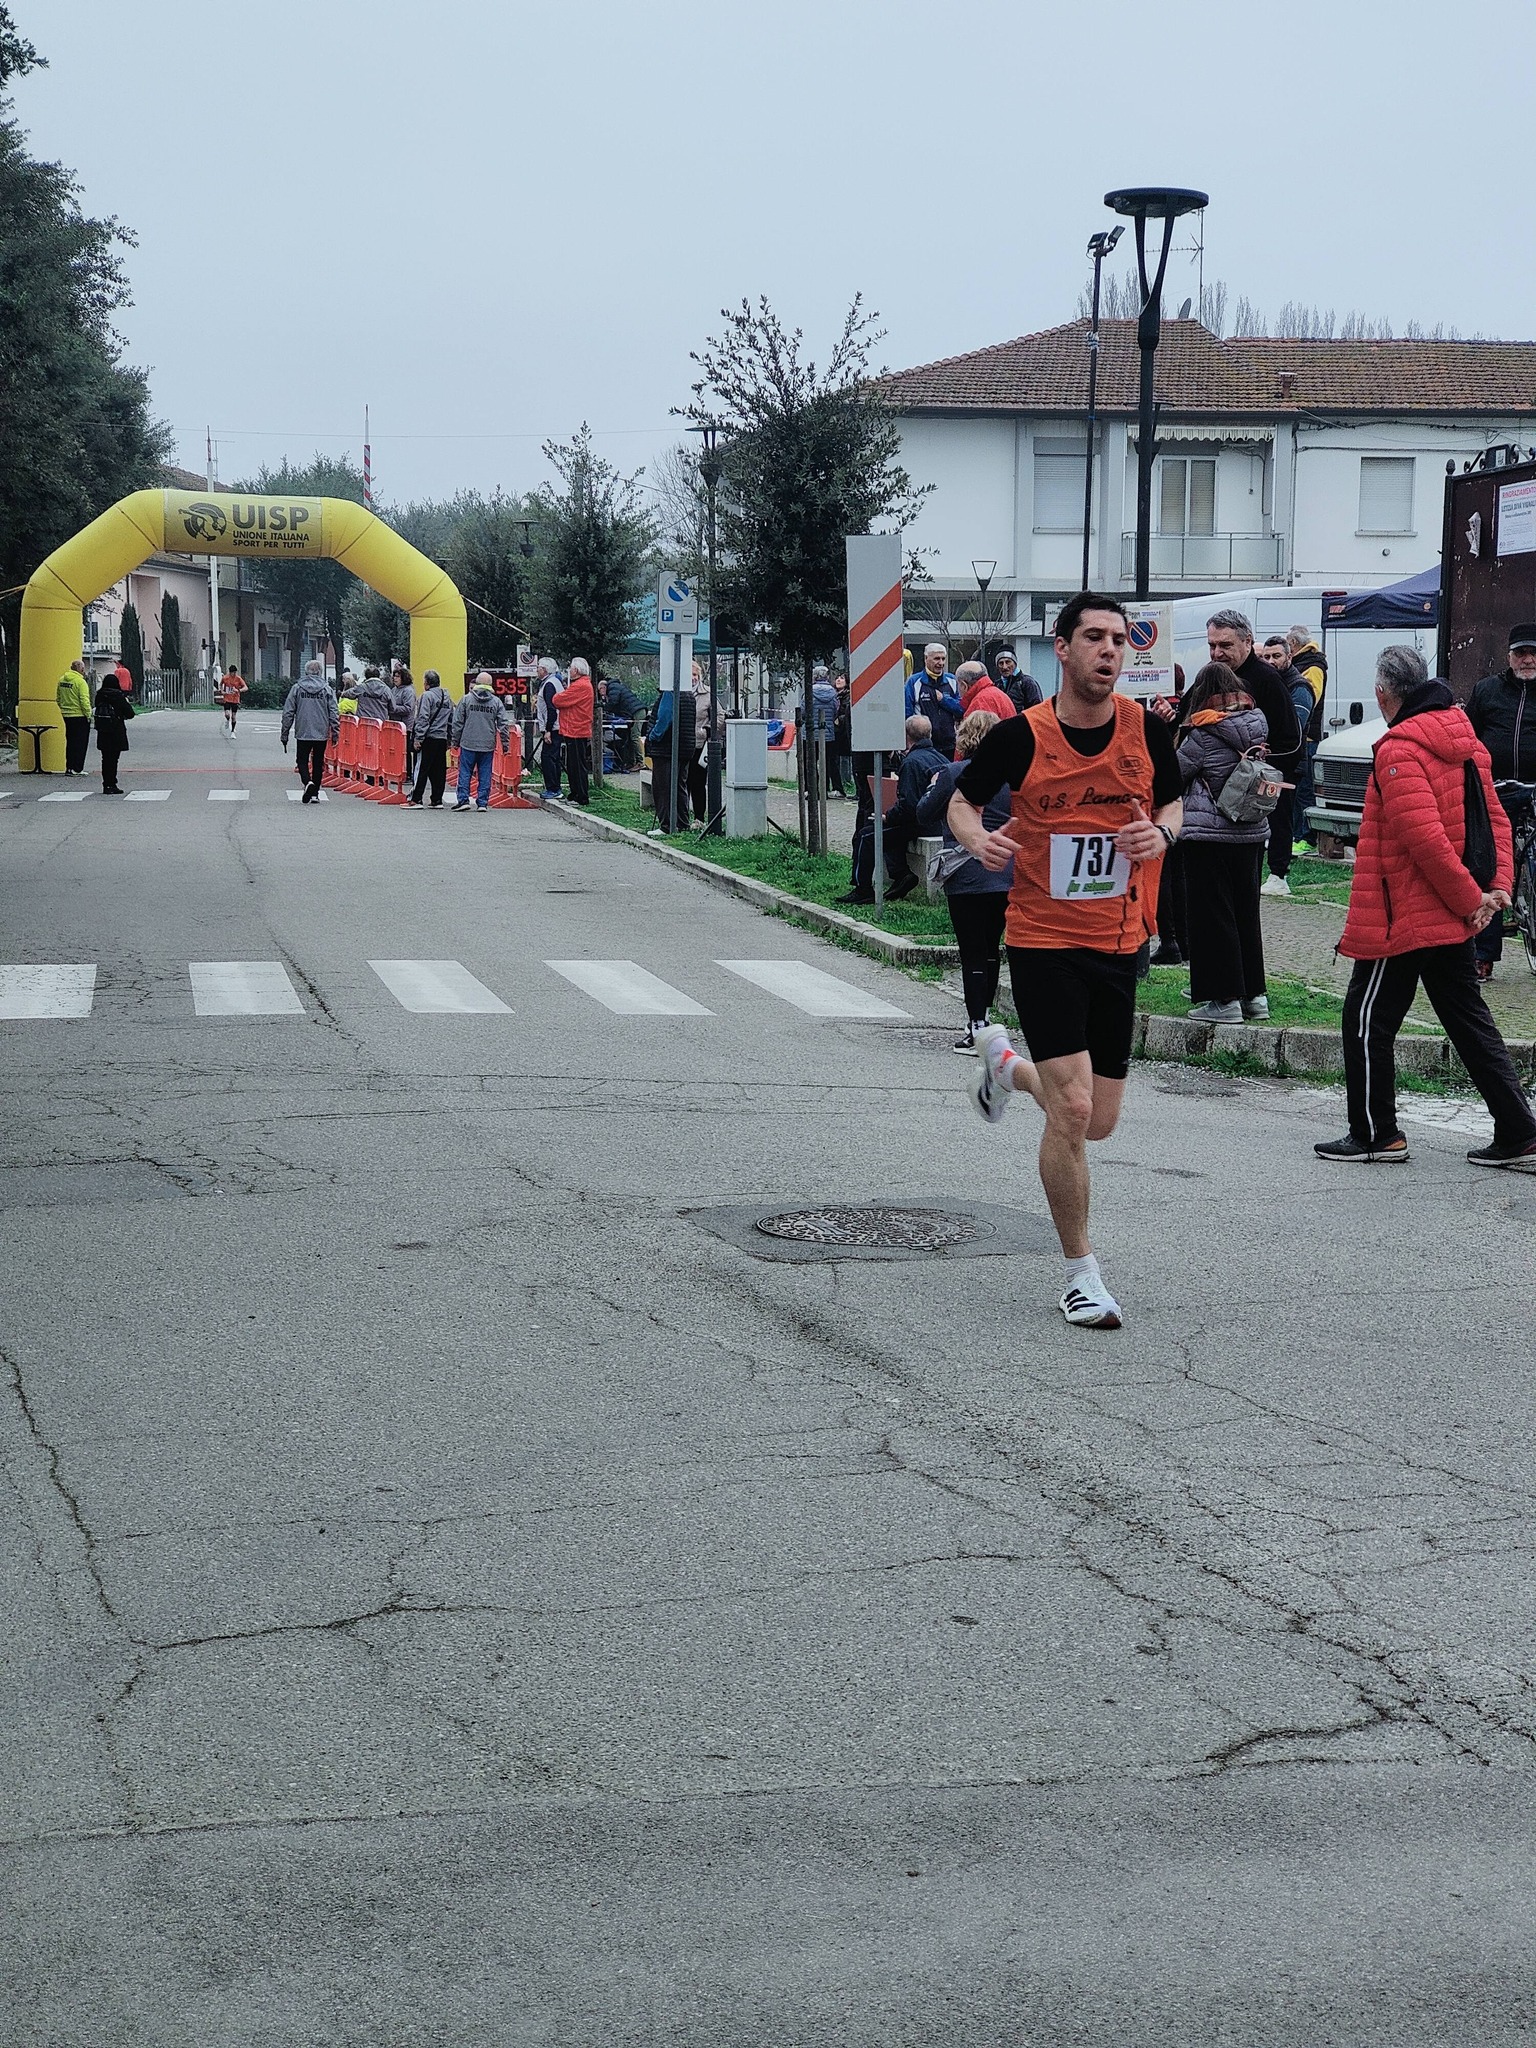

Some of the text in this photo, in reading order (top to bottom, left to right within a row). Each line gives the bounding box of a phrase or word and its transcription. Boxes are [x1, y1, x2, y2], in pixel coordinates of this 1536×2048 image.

[232, 504, 309, 531] UISP
[232, 531, 310, 541] UNIONE ITALIANA
[232, 539, 305, 549] SPORT PER TUTTI
[470, 704, 494, 713] GIUDICE
[1071, 836, 1119, 877] 737
